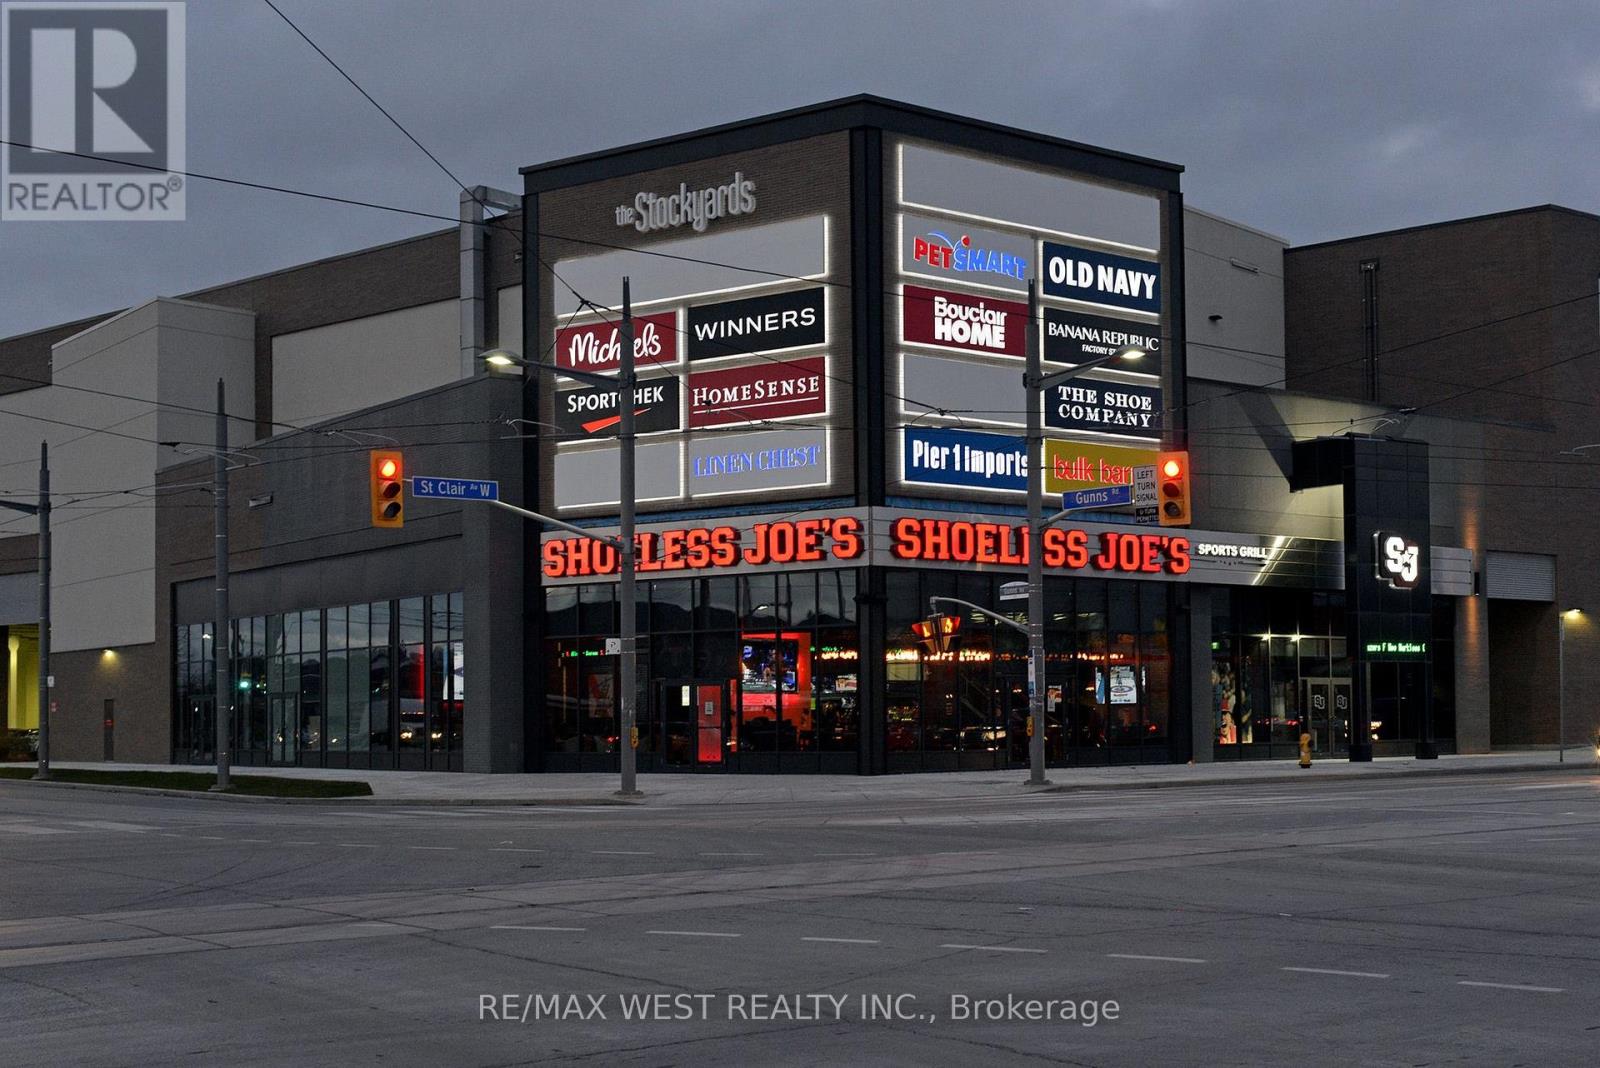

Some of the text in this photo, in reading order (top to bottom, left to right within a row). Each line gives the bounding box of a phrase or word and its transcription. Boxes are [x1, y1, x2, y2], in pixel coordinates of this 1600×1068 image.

[615, 171, 757, 232] the Stockyards
[1048, 256, 1157, 300] OLD NAVY
[694, 307, 816, 341] WINNERS
[934, 296, 1008, 327] Bouclair
[568, 322, 662, 367] Michels
[934, 316, 1006, 349] HOME
[1048, 321, 1100, 343] BANANA
[1081, 344, 1108, 355] FACTORY
[1058, 385, 1152, 411] THE SHOE
[1058, 403, 1152, 428] COMPANY
[694, 444, 821, 478] LINEN CHEST
[912, 439, 950, 470] Pier
[952, 443, 961, 472] 1
[1053, 454, 1095, 483] bulk
[420, 480, 434, 494] St
[438, 481, 466, 496] Clair
[480, 484, 490, 497] W
[1136, 470, 1154, 480] LEFT
[1136, 481, 1156, 491] TURN
[1076, 487, 1119, 505] Gunns Rd
[1136, 493, 1158, 502] SIGNAL
[743, 516, 861, 565] JOE'S
[1099, 532, 1191, 574] JOE'S
[1198, 543, 1268, 559] SPORTS GRILL
